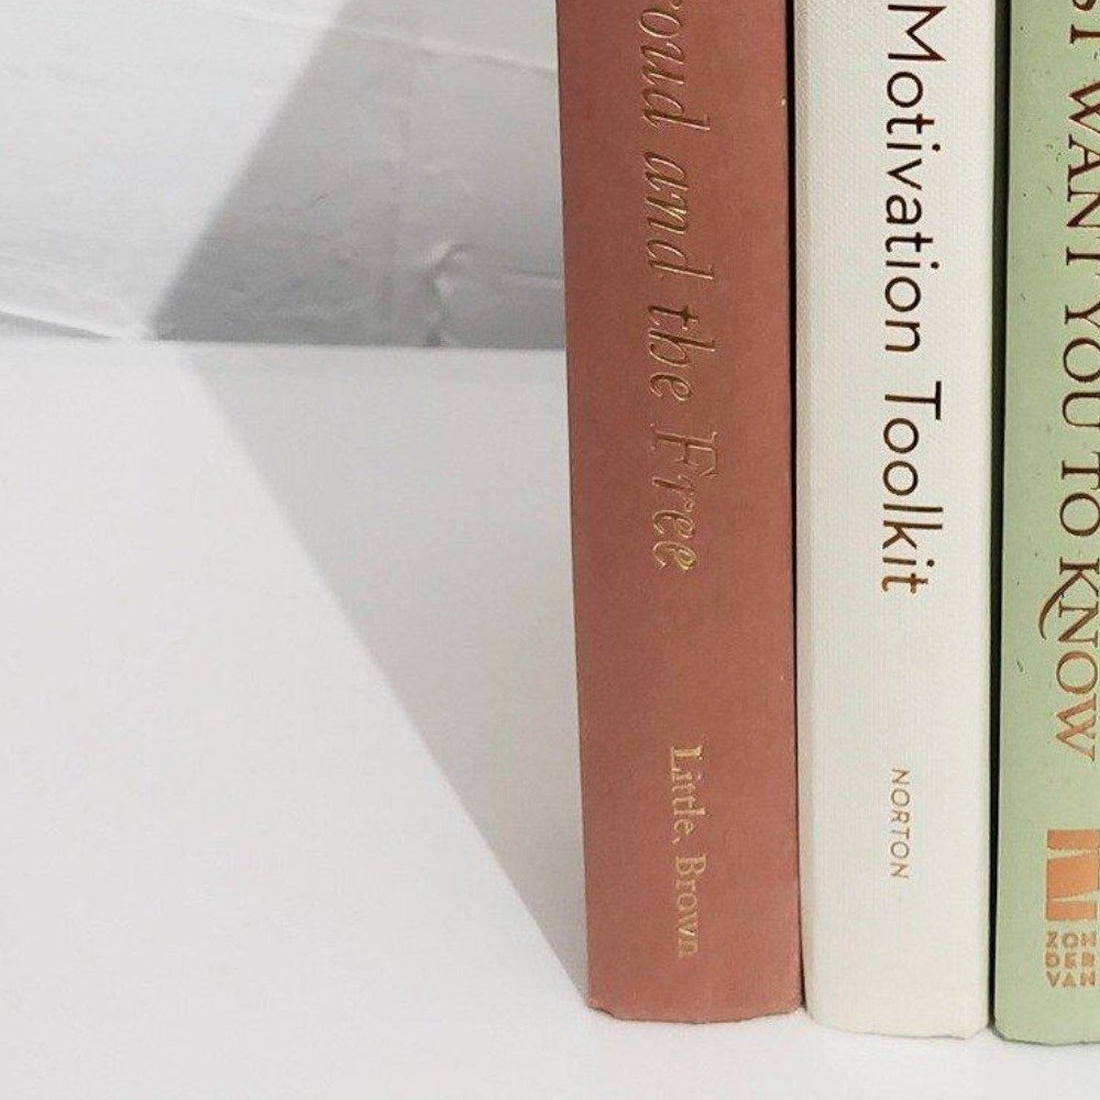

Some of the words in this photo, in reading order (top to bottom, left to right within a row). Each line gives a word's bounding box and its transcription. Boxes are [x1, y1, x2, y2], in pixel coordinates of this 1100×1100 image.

[643, 151, 714, 280] and
[885, 4, 947, 352] Motivation
[647, 304, 716, 400] the
[650, 421, 718, 571] Free
[881, 380, 944, 594] Toolkit
[1038, 557, 1100, 761] KNOW
[889, 767, 911, 880] NORTON
[675, 854, 707, 959] Brown
[1047, 931, 1098, 948] ZON
[1046, 970, 1096, 989] VAN
